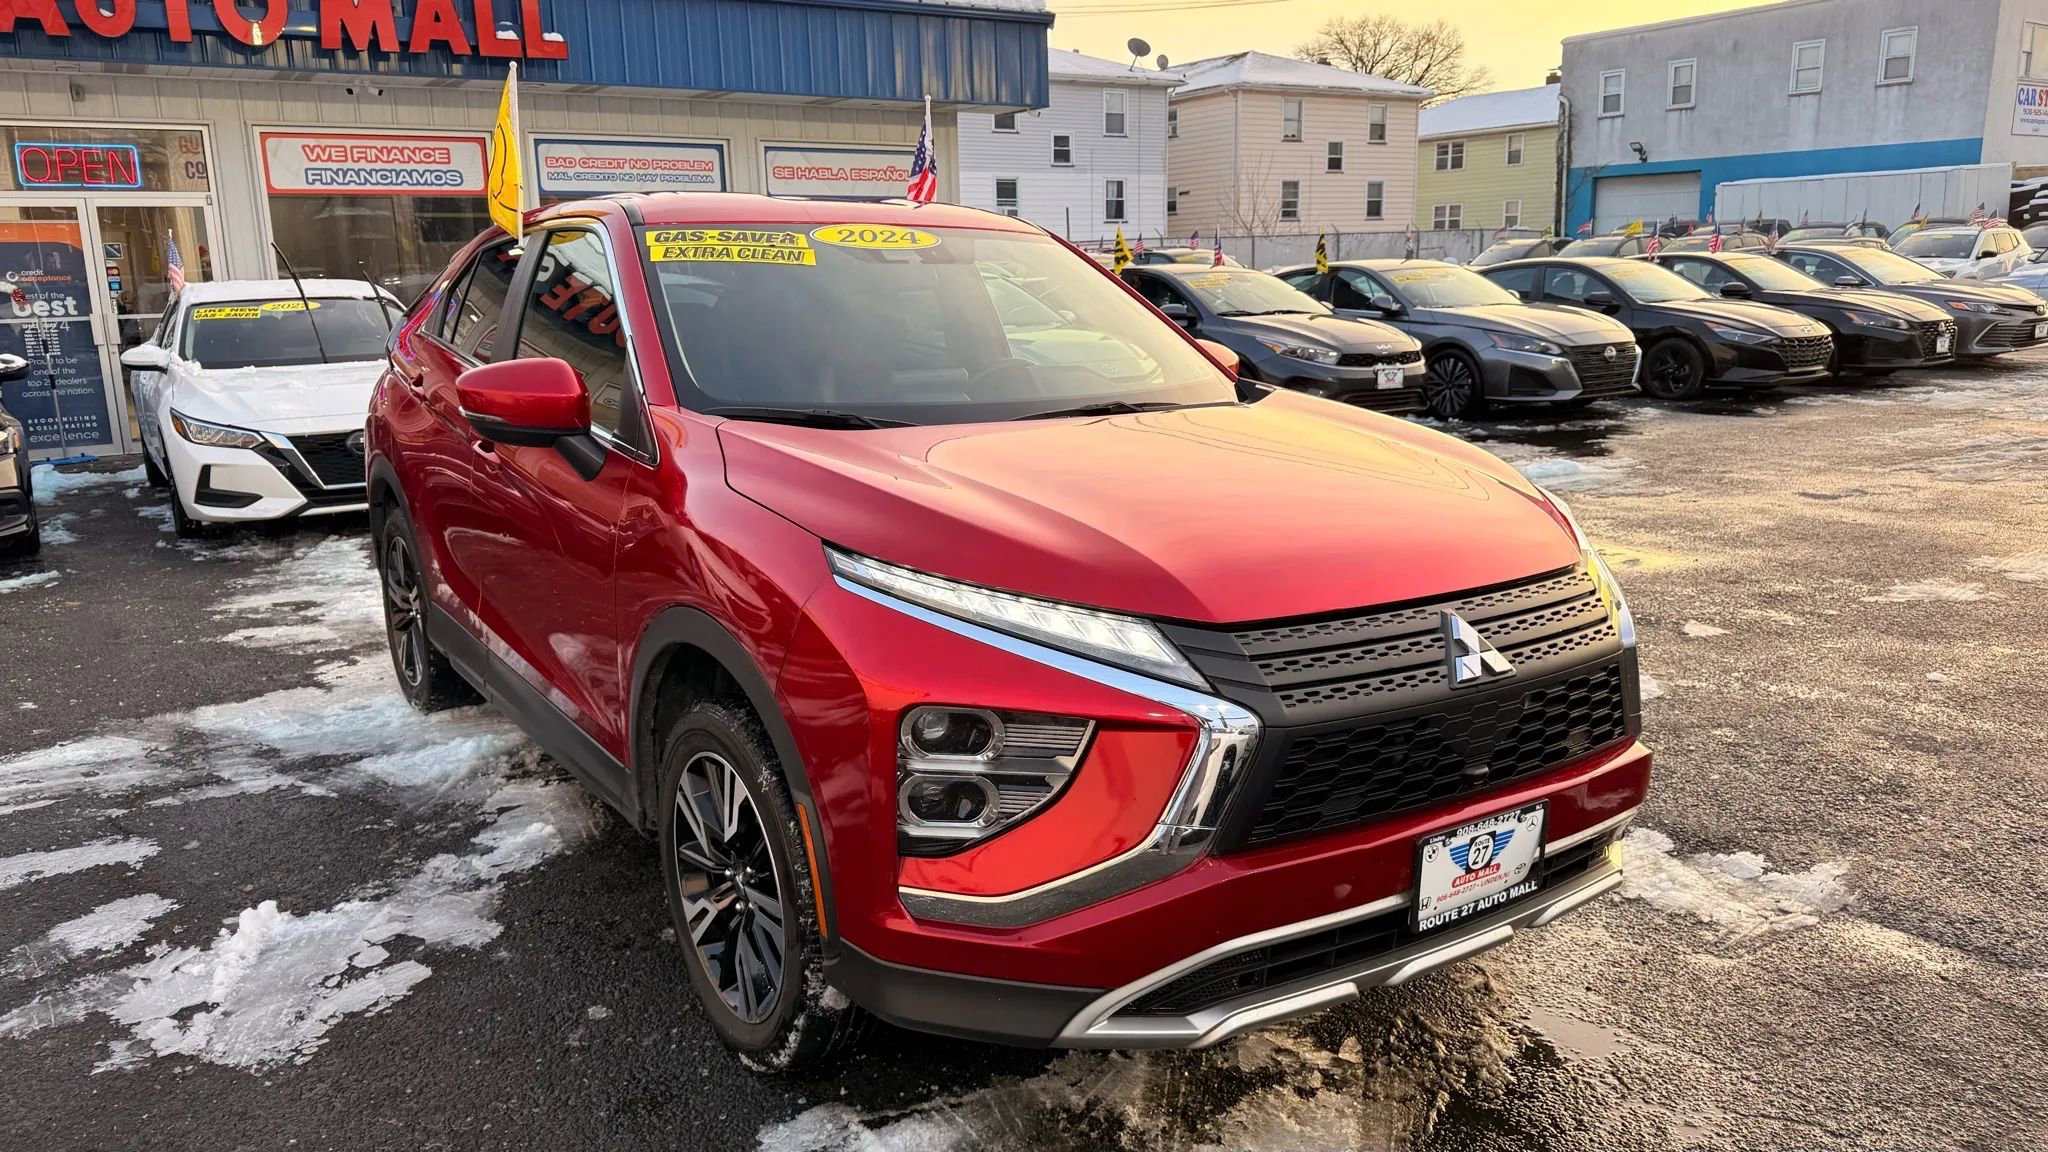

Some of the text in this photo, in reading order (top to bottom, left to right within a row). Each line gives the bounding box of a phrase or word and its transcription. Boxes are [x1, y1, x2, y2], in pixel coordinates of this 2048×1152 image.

[320, 0, 569, 60] MALL
[2018, 88, 2037, 106] CAR
[302, 145, 451, 164] WE FINANCE
[20, 147, 136, 184] OPEN
[545, 157, 714, 171] BAD CREDIT NO PROBLEM
[305, 168, 463, 186] FINANCIAMOS
[547, 172, 714, 183] MAL CREDITO NO HAY PROBLEMA
[772, 165, 911, 182] SE HABLA ESPAÑOL
[654, 231, 799, 246] GAS-SAVER
[837, 229, 922, 245] 2024
[662, 246, 805, 262] EXTRA CLEAN
[21, 275, 72, 283] acceptance
[24, 291, 65, 300] est of the
[65, 356, 78, 364] be
[62, 367, 76, 375] the
[55, 377, 87, 386] dealers
[22, 390, 51, 398] across
[36, 422, 98, 431] CELERATING
[30, 431, 100, 443] excelence
[1473, 837, 1491, 848] ROUTE
[1471, 845, 1490, 866] 27
[1454, 864, 1498, 886] AUTO MALL
[1419, 880, 1538, 932] ROUTE 27 AUTO MALL
